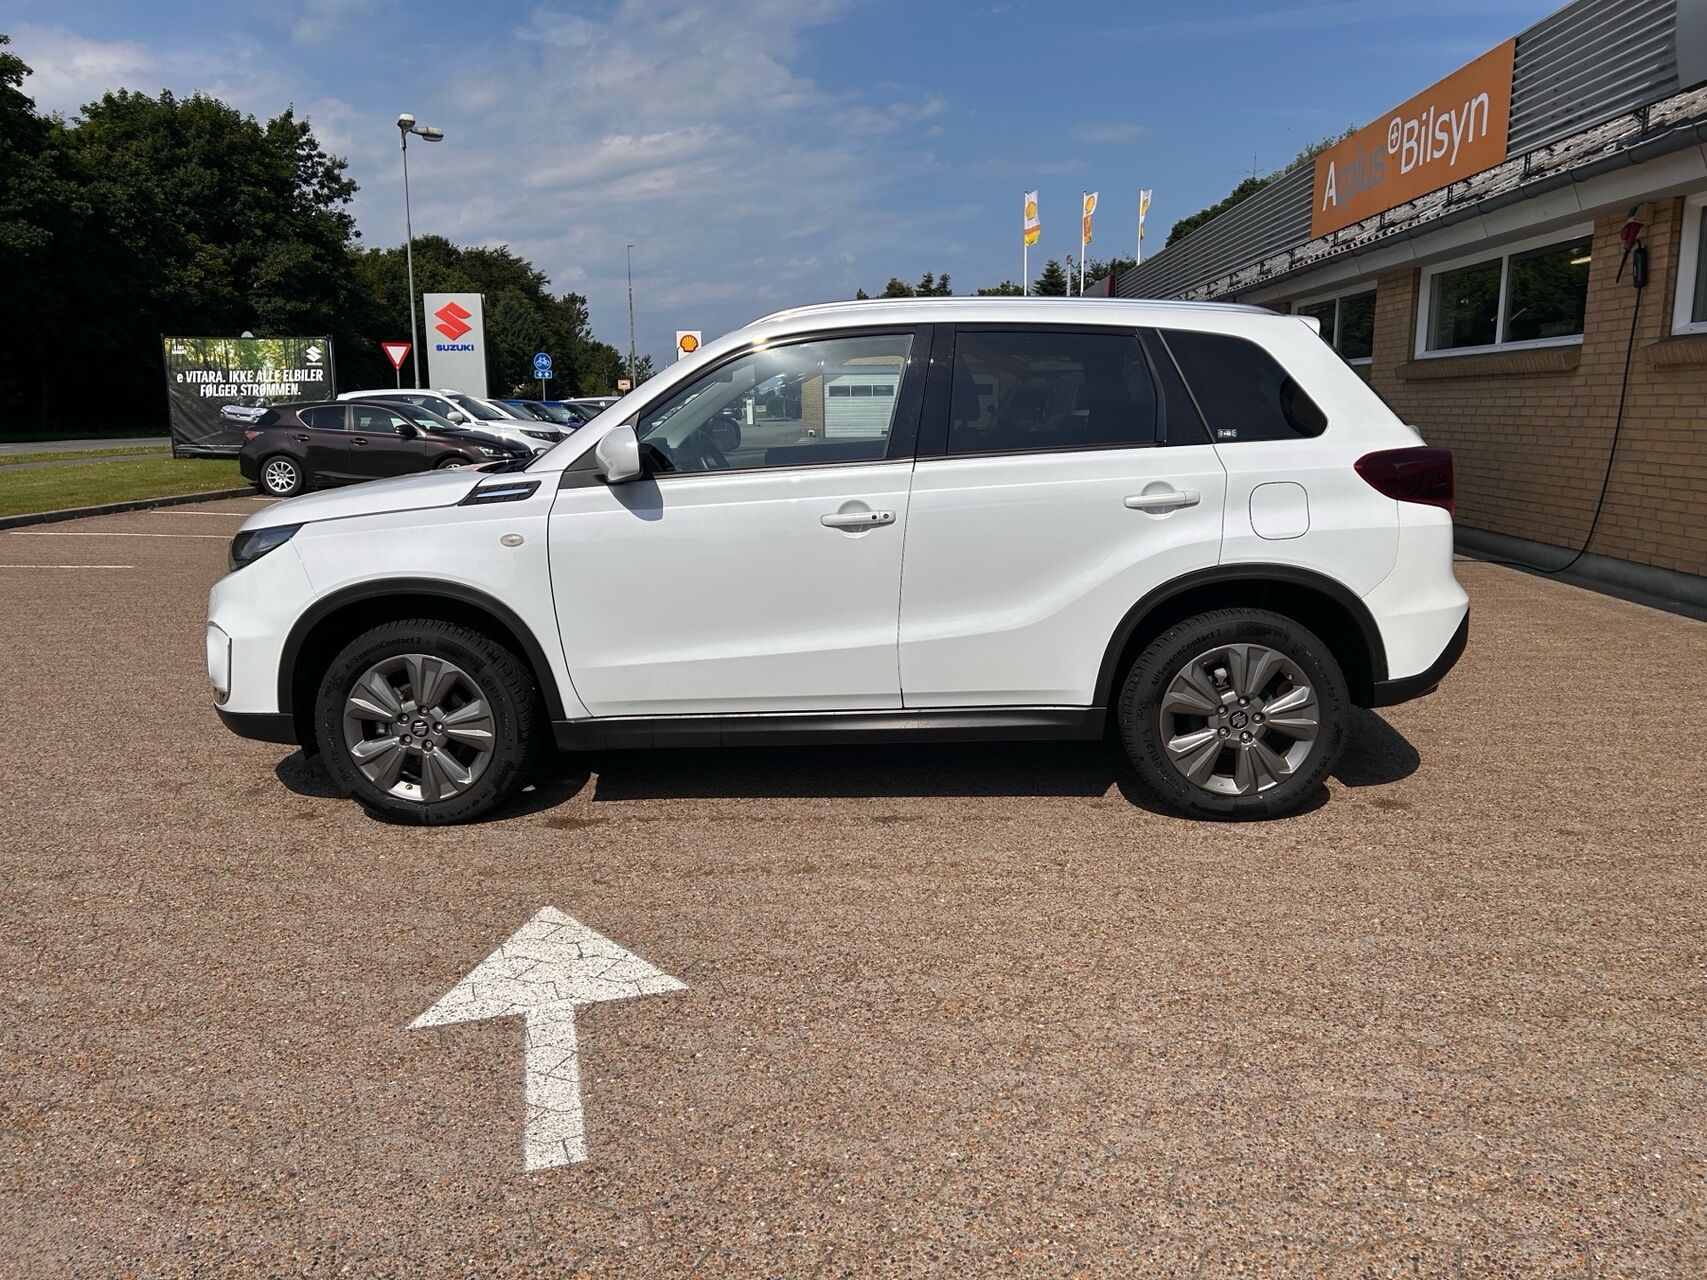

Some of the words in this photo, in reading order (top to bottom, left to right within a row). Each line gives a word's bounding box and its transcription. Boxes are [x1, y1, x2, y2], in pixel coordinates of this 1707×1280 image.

[1400, 91, 1489, 176] Bilsyn
[435, 344, 475, 352] SUZUKI
[176, 373, 183, 383] e
[185, 370, 226, 383] VITARA.
[229, 370, 254, 383] IKKE
[256, 369, 282, 382] ALLE
[283, 369, 324, 382] ELBILER
[200, 383, 238, 398] FØLGER
[240, 382, 302, 397] STRØMMEN.
[416, 636, 422, 645] 2
